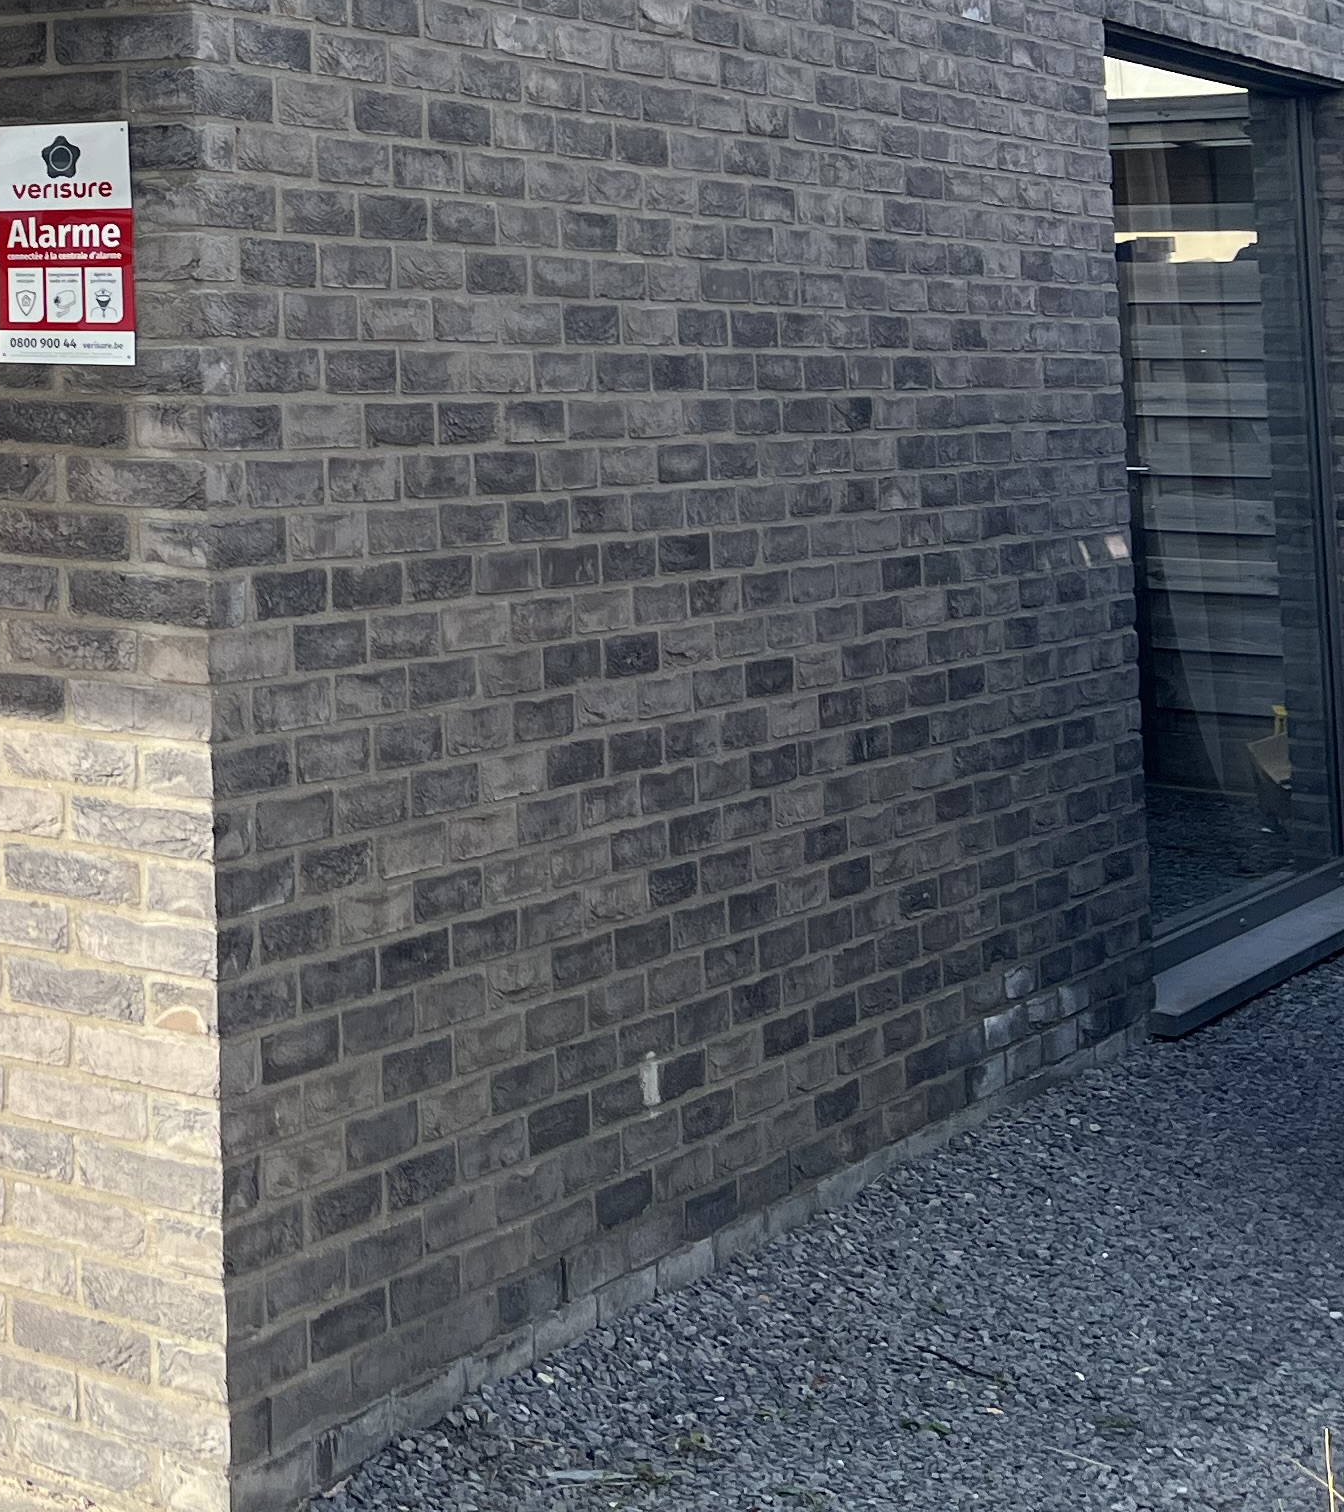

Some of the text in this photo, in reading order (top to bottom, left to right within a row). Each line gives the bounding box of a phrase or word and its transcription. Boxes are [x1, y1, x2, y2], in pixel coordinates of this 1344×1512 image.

[12, 181, 113, 199] verisure
[7, 216, 121, 249] Alarme
[10, 337, 77, 349] 0800 900 44
